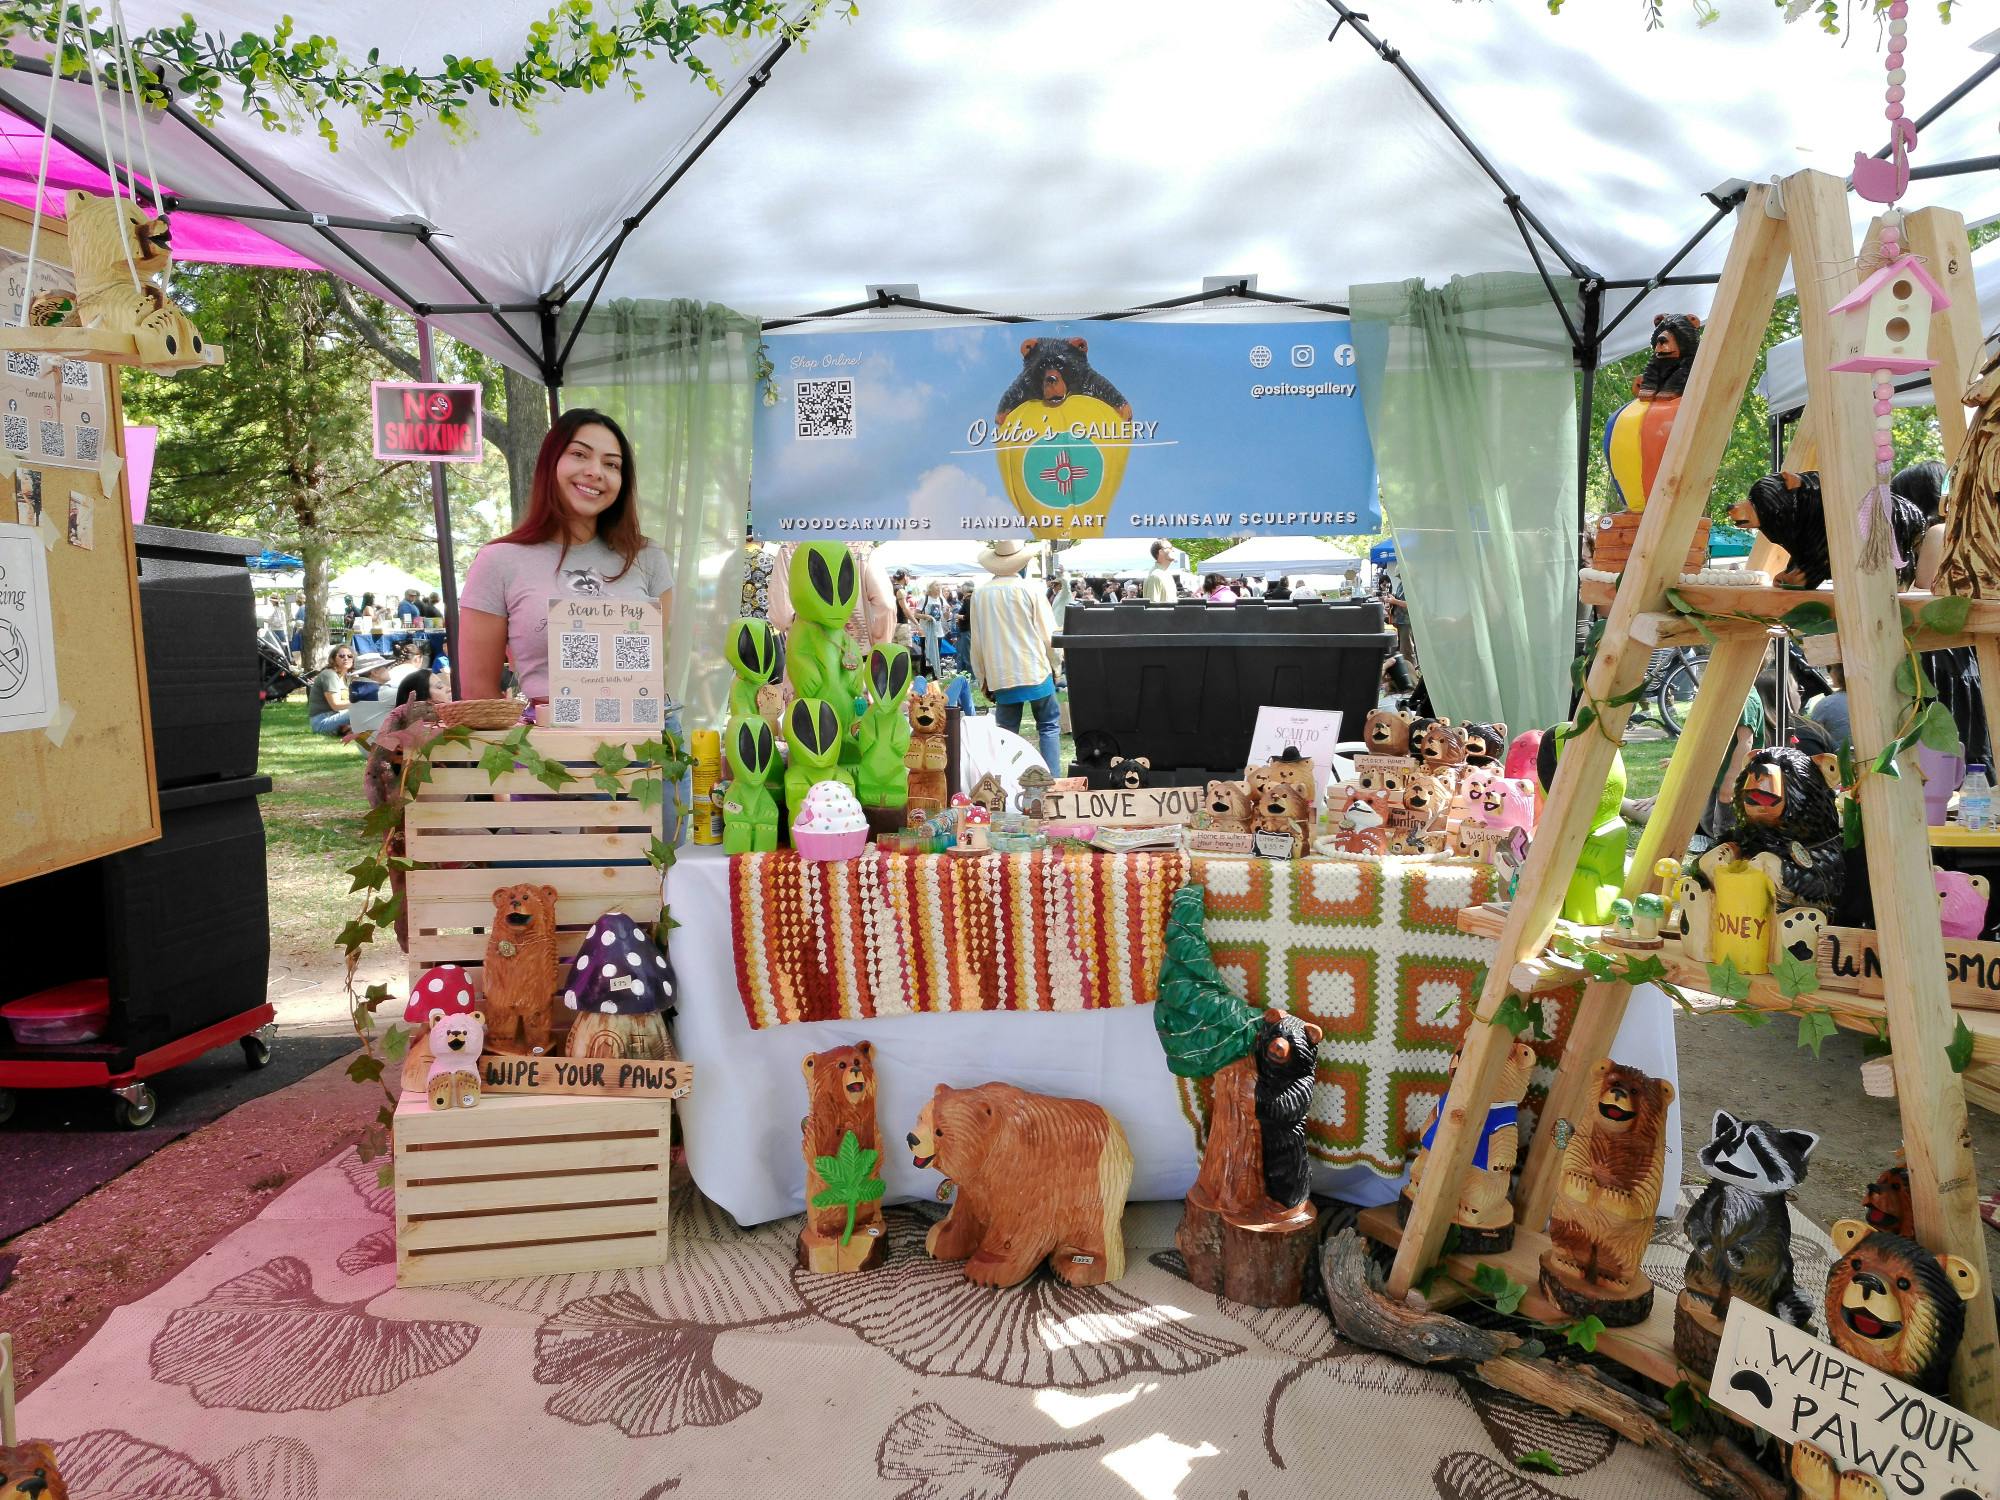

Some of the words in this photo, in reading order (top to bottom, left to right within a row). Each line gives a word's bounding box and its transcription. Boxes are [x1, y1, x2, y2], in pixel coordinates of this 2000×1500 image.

[790, 355, 817, 373] Shop
[822, 351, 863, 368] Online!
[1251, 382, 1356, 399] @ositosgallery
[385, 421, 473, 452] SMOKING
[967, 415, 1059, 446] Osito's
[1070, 419, 1159, 440] GALLERY
[779, 516, 932, 531] WOODCARVINGS
[961, 515, 1063, 529] HANDMADE
[1071, 513, 1106, 527] ART
[1130, 512, 1233, 527] CHAINSAW
[1239, 511, 1358, 525] SCULPTURES
[568, 602, 600, 616] Scan
[602, 603, 615, 617] to
[621, 603, 644, 620] Pay
[1306, 729, 1320, 742] TO
[1046, 795, 1066, 819] I
[1075, 793, 1137, 819] LOVE
[1150, 790, 1198, 818] YOU
[1197, 832, 1218, 840] Home
[1215, 841, 1233, 849] honey
[486, 1061, 540, 1087] WIPE
[555, 1062, 605, 1087] YOUR
[619, 1063, 677, 1089] PAWS
[1765, 1326, 1865, 1408] WIPE
[1875, 1382, 1979, 1471] YOUR
[1790, 1393, 1927, 1496] PAWS
